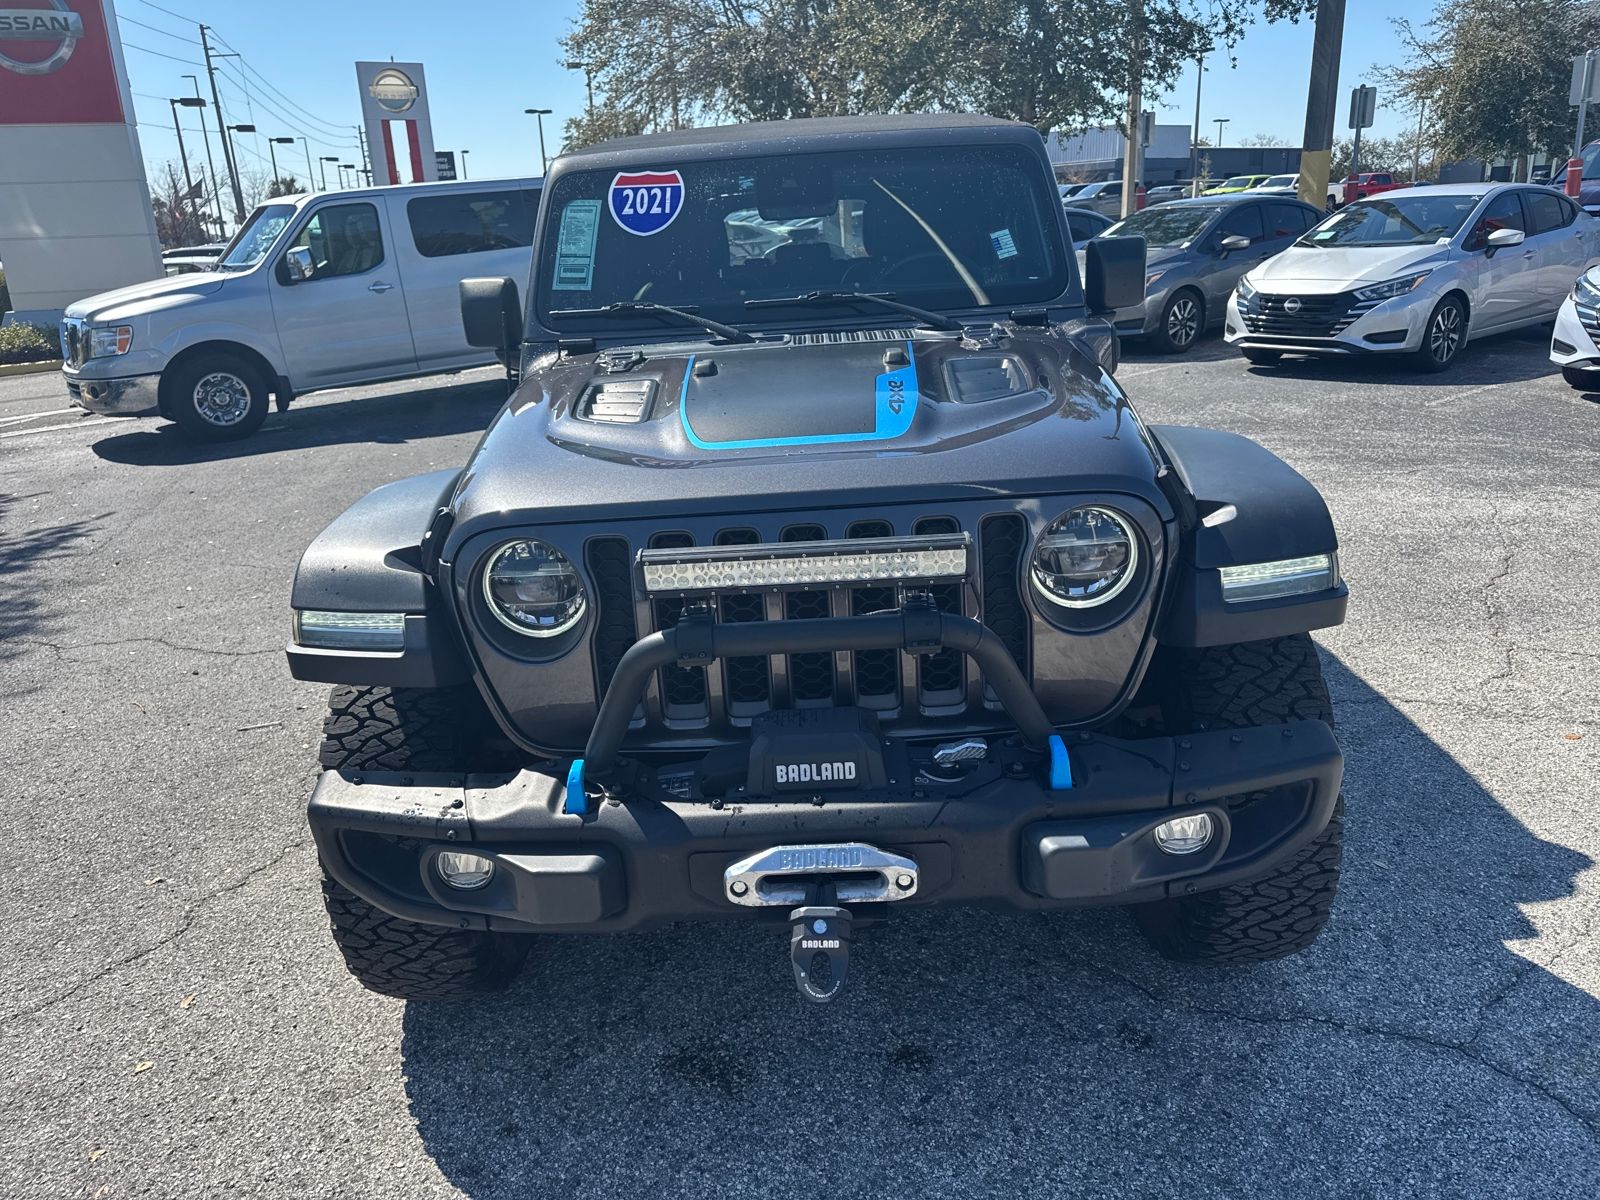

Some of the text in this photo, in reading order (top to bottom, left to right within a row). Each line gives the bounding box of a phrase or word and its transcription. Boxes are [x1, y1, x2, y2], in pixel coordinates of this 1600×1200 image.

[621, 187, 671, 215] 2021
[776, 761, 856, 783] BADLAND
[801, 939, 840, 949] BADLAND
